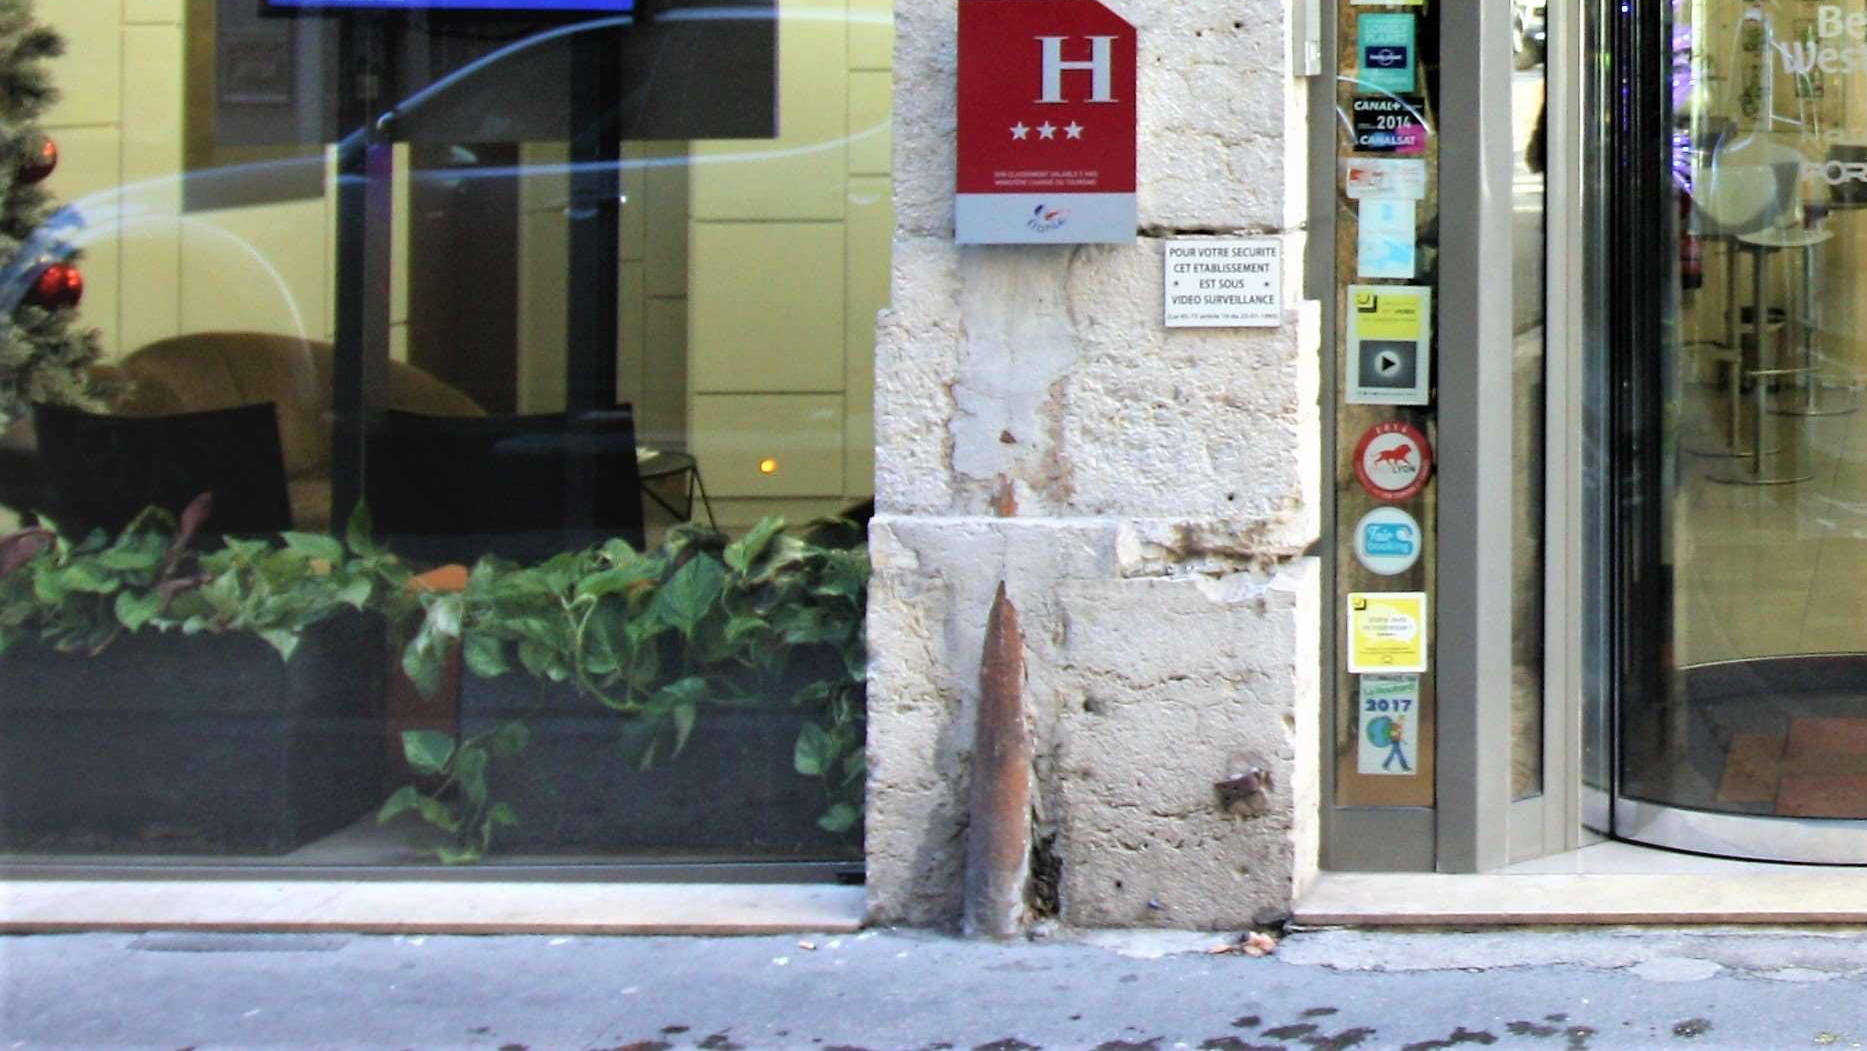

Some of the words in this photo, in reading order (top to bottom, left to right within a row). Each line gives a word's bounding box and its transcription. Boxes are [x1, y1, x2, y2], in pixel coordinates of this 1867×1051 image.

[1033, 35, 1119, 104] H
[1354, 101, 1401, 111] CANAL+
[1376, 115, 1412, 130] 2014
[1359, 135, 1416, 145] CANALSAT
[1169, 247, 1196, 257] POUR
[1198, 247, 1229, 257] VOTRE
[1231, 247, 1277, 257] SECURITE
[1173, 263, 1191, 273] CET
[1193, 263, 1270, 273] ETABLISSEMENT
[1199, 279, 1216, 289] EST
[1218, 279, 1245, 289] SOUS
[1172, 295, 1202, 305] VIDEO
[1204, 295, 1275, 305] SURVEILLANCE
[1364, 698, 1413, 712] 2017
